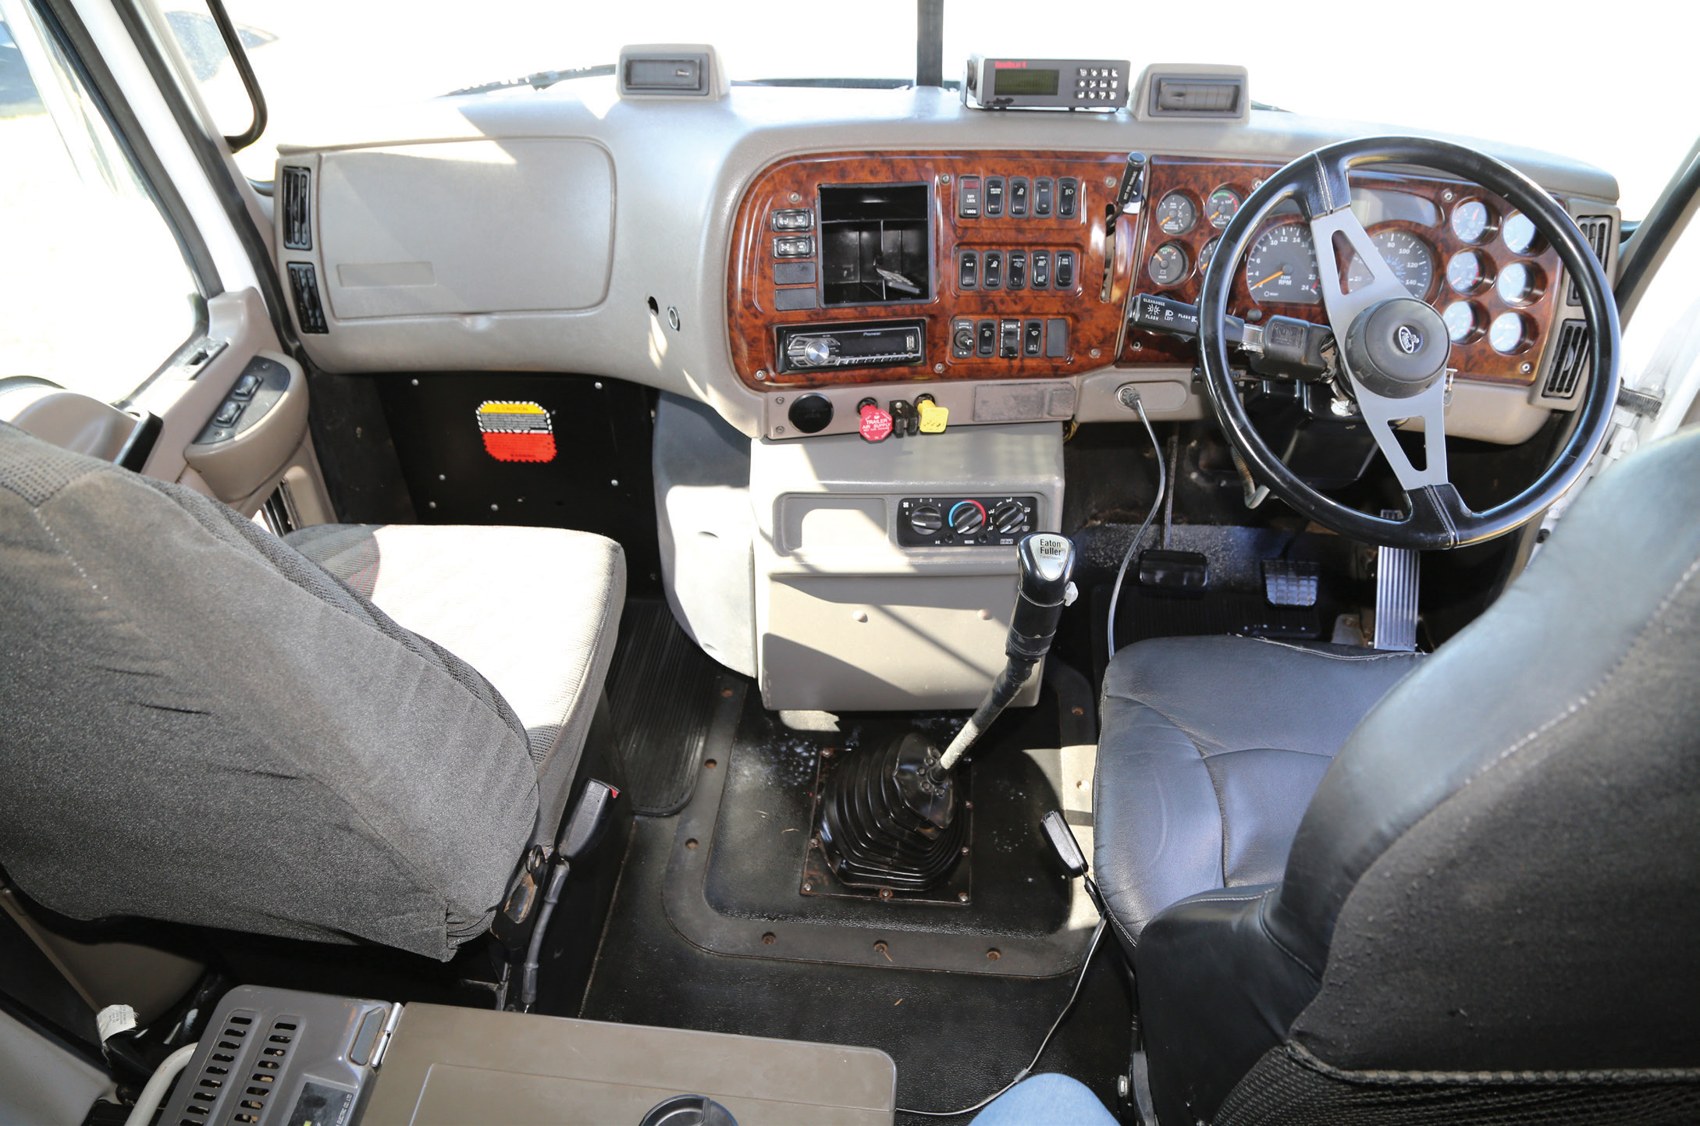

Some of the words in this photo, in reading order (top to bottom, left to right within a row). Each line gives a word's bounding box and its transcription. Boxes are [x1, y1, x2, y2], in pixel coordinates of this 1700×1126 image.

[1143, 298, 1165, 306] CLEARANCE
[1040, 539, 1061, 548] Eaton
[1040, 547, 1061, 556] Fuller
